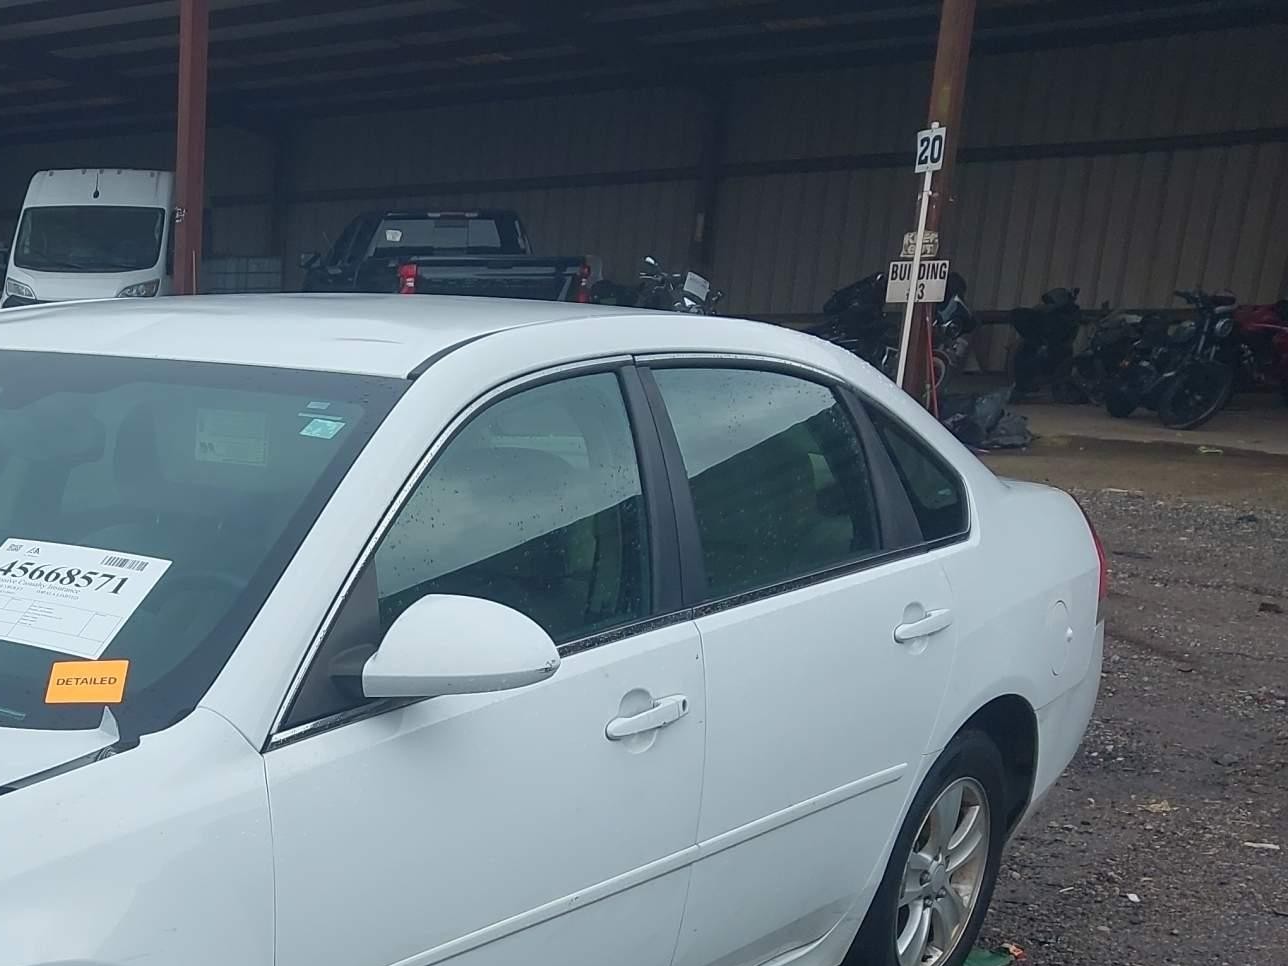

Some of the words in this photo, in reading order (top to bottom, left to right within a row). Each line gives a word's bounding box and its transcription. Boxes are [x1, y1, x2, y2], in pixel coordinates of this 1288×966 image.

[918, 135, 943, 165] 20
[904, 231, 937, 243] KEP
[890, 263, 948, 281] BUIDING
[46, 582, 81, 594] Insurance
[56, 676, 117, 686] DETAILED
